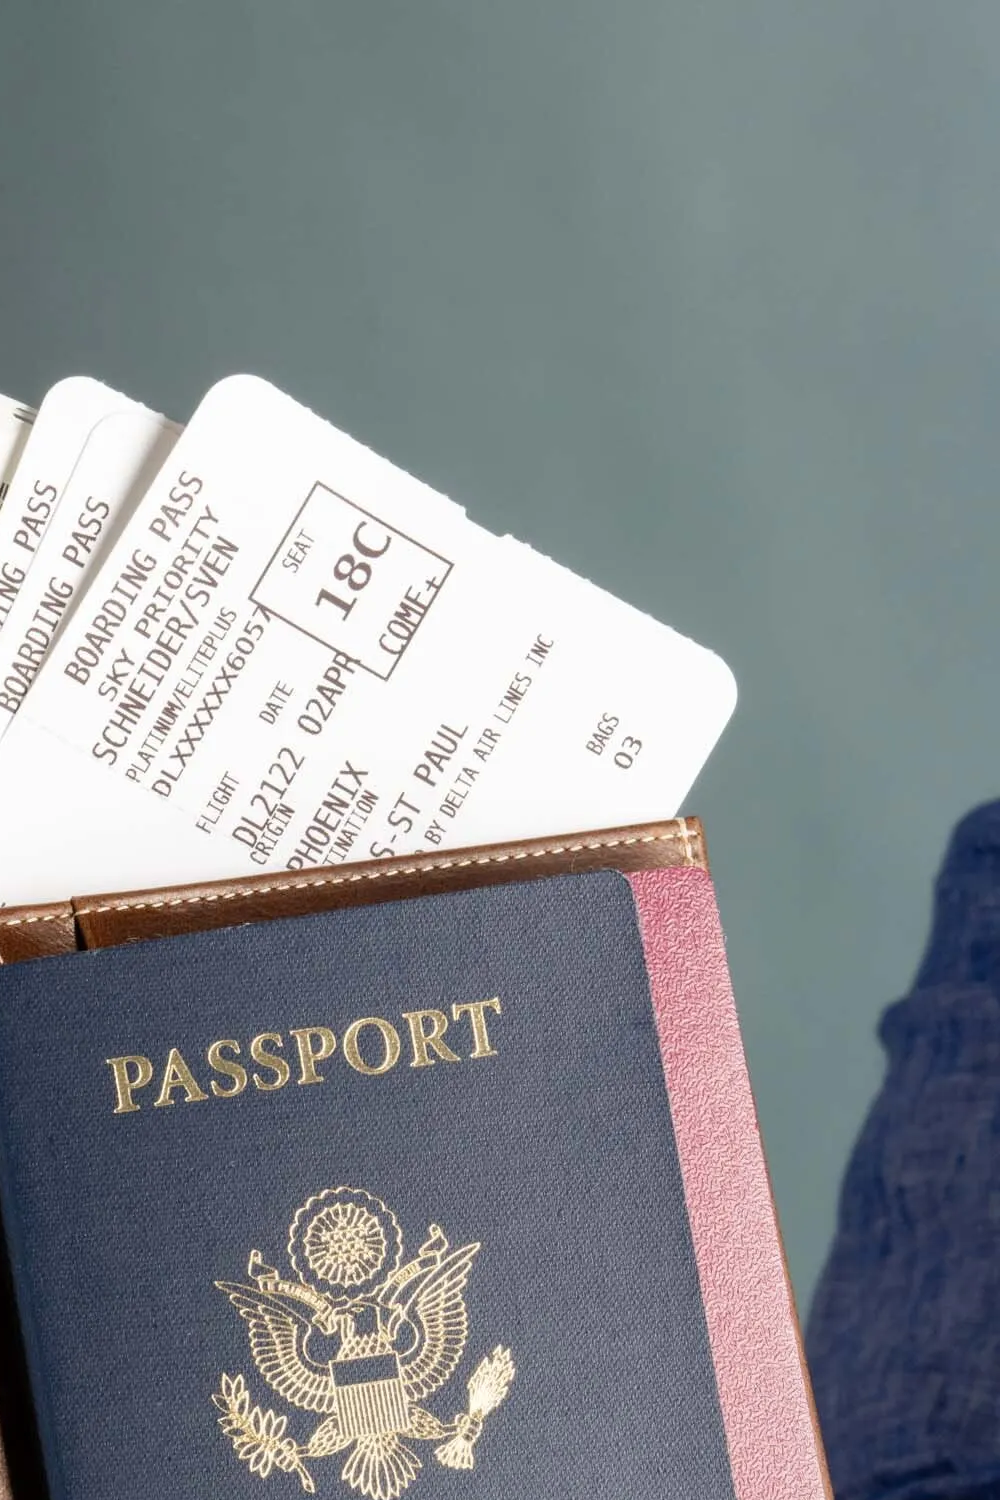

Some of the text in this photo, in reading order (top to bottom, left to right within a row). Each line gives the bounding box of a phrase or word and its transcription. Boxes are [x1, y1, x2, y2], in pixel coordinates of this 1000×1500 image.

[13, 479, 58, 553] PASS
[62, 495, 111, 568] PASS
[283, 530, 313, 573] SEAT
[64, 471, 202, 685] BOARDING PASS
[99, 506, 218, 701] SKY PRIORITY
[316, 521, 391, 621] 18C
[93, 536, 239, 765] SCHNEIDER/SVEN
[126, 608, 236, 782] PLATINUM/ELITEPLUS
[152, 603, 272, 797] DLXXXXXX6057
[232, 650, 364, 848] DL2122 02APR
[259, 681, 293, 724] DATE
[424, 635, 553, 845] BY DELTA AIR LINES INC
[586, 713, 619, 755] BAGS
[615, 736, 642, 769] 03
[196, 771, 239, 833] FLIGHT
[414, 725, 468, 786] PAUL
[286, 761, 368, 870] PHOENIX
[322, 790, 378, 867] TINATION
[105, 996, 502, 1115] PASSPORT
